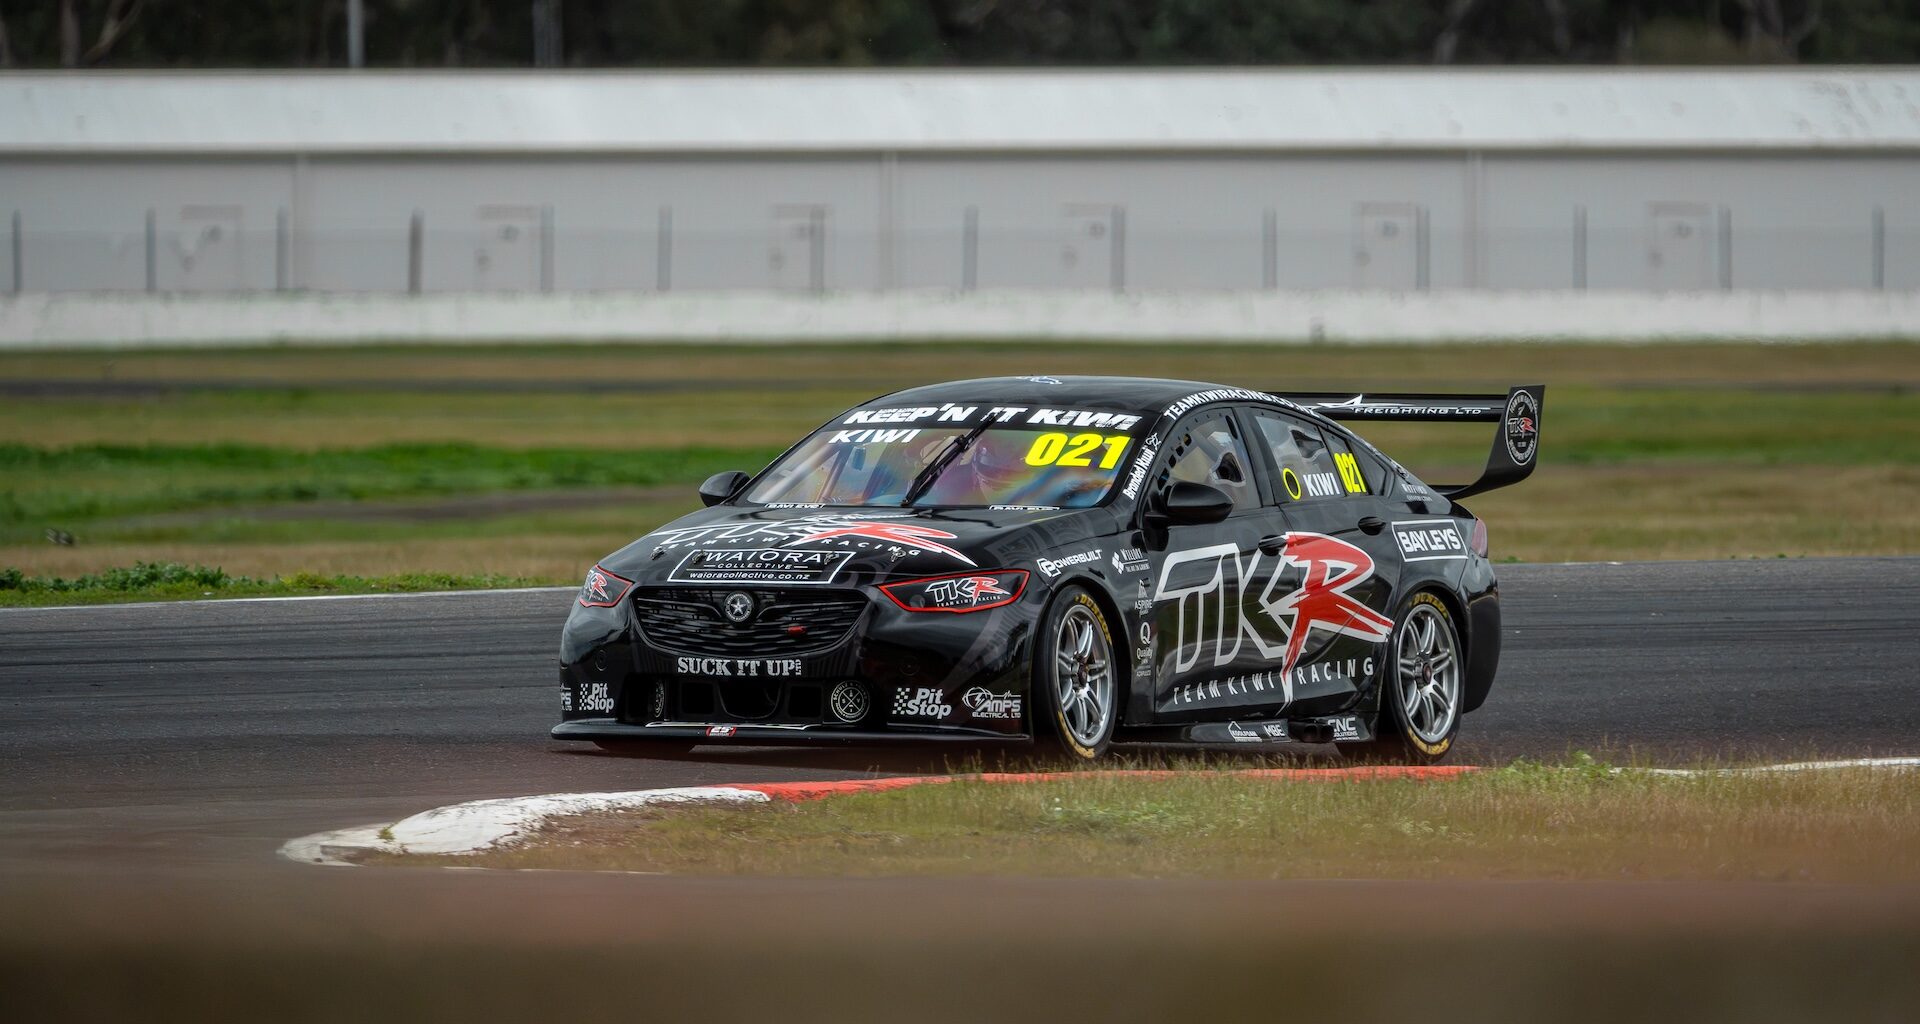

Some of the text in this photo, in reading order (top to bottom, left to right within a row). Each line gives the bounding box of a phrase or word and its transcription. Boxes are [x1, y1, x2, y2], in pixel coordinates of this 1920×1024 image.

[843, 402, 978, 425] KEEP'N
[1026, 408, 1143, 431] KIWI
[1354, 406, 1482, 415] FREIGHTING LTD
[829, 428, 922, 444] KIWI
[1024, 432, 1131, 470] 021
[1333, 452, 1367, 494] 021
[1302, 472, 1341, 497] KIWI
[1397, 528, 1462, 553] BAYLEYS
[704, 551, 823, 563] WAIORA
[1036, 549, 1103, 578] POWERBUILT
[689, 571, 811, 580] waioracollective.co.nz
[924, 577, 1011, 606] TKR
[1134, 599, 1153, 610] ASPIRE
[1153, 531, 1396, 715] TKR
[1136, 647, 1153, 660] Quality
[677, 656, 732, 676] SUCK
[736, 659, 761, 676] IT
[766, 659, 795, 676] UP
[592, 682, 608, 699] Pit
[1173, 656, 1374, 705] TEAM KIWI RACING
[586, 694, 615, 714] Stop
[915, 687, 943, 705] Pit
[974, 699, 1022, 713] AMPS
[905, 698, 952, 720] Stop
[1263, 724, 1286, 737] MBE
